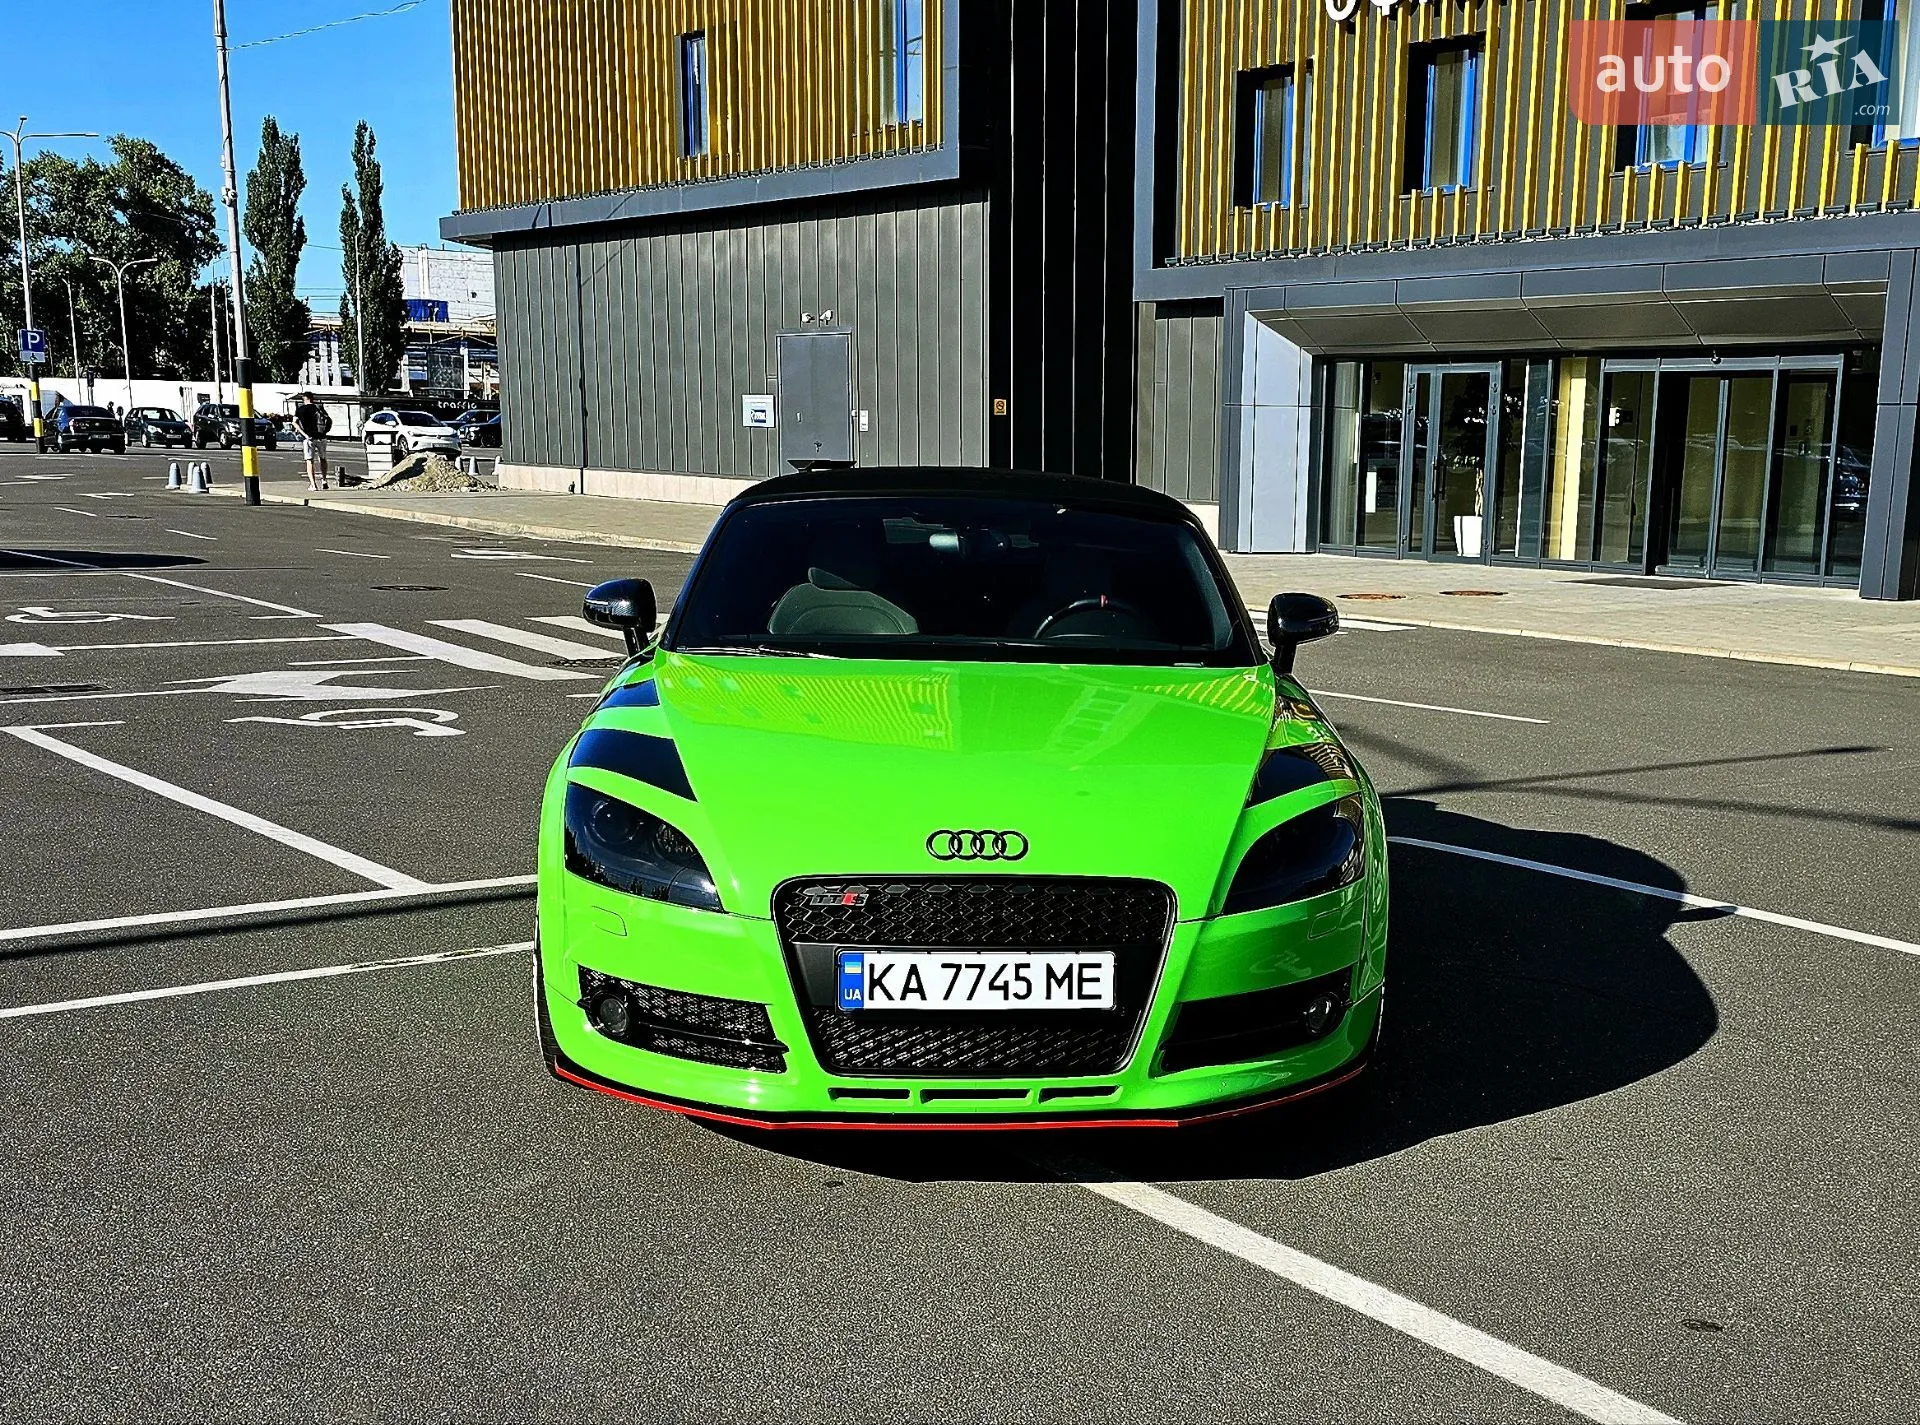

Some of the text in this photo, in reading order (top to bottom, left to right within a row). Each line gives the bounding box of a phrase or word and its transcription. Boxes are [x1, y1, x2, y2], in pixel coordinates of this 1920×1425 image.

[27, 332, 40, 349] P
[868, 963, 1102, 1000] KA 7745 ME
[844, 988, 862, 1001] UA
